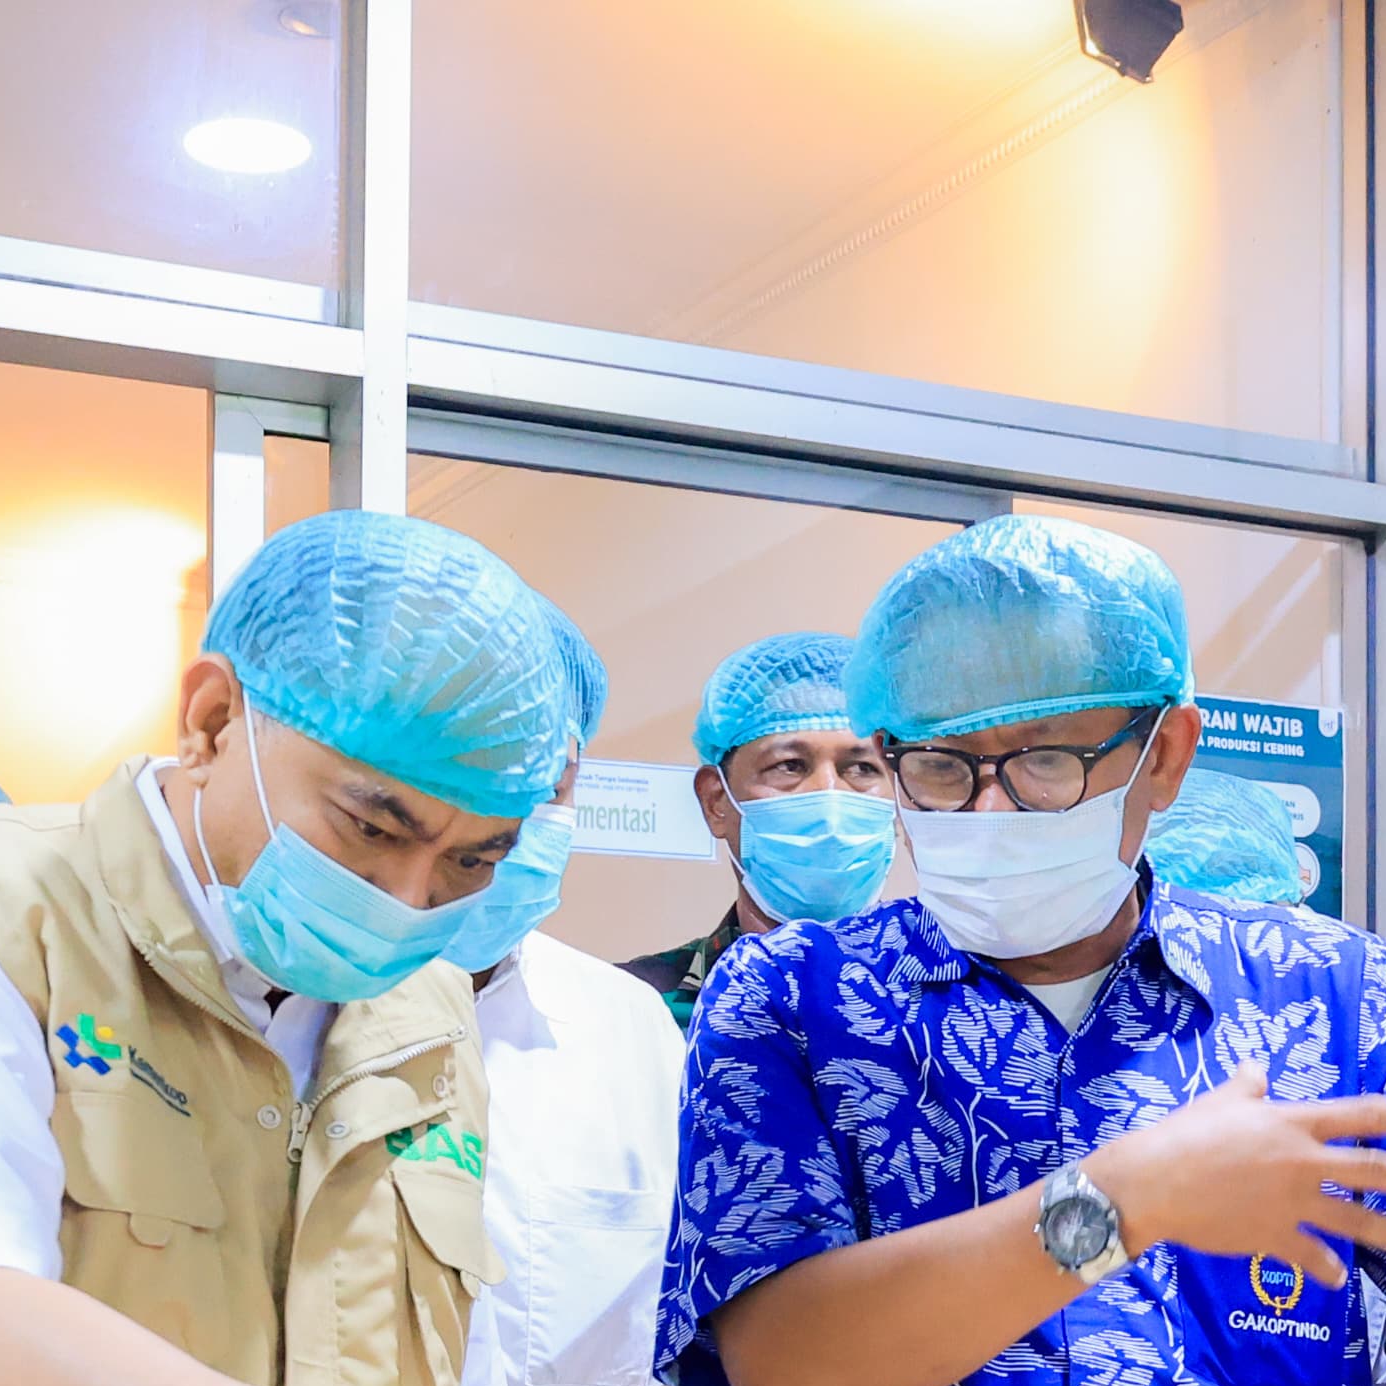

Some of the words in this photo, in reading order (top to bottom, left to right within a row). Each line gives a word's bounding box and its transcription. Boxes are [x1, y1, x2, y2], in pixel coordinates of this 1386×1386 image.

[1242, 713, 1304, 738] WAJIB
[1207, 735, 1261, 753] PRODUKSI
[1263, 741, 1305, 758] KERING
[577, 804, 656, 833] mentasi
[1228, 1310, 1331, 1342] GAKOPTINDO
